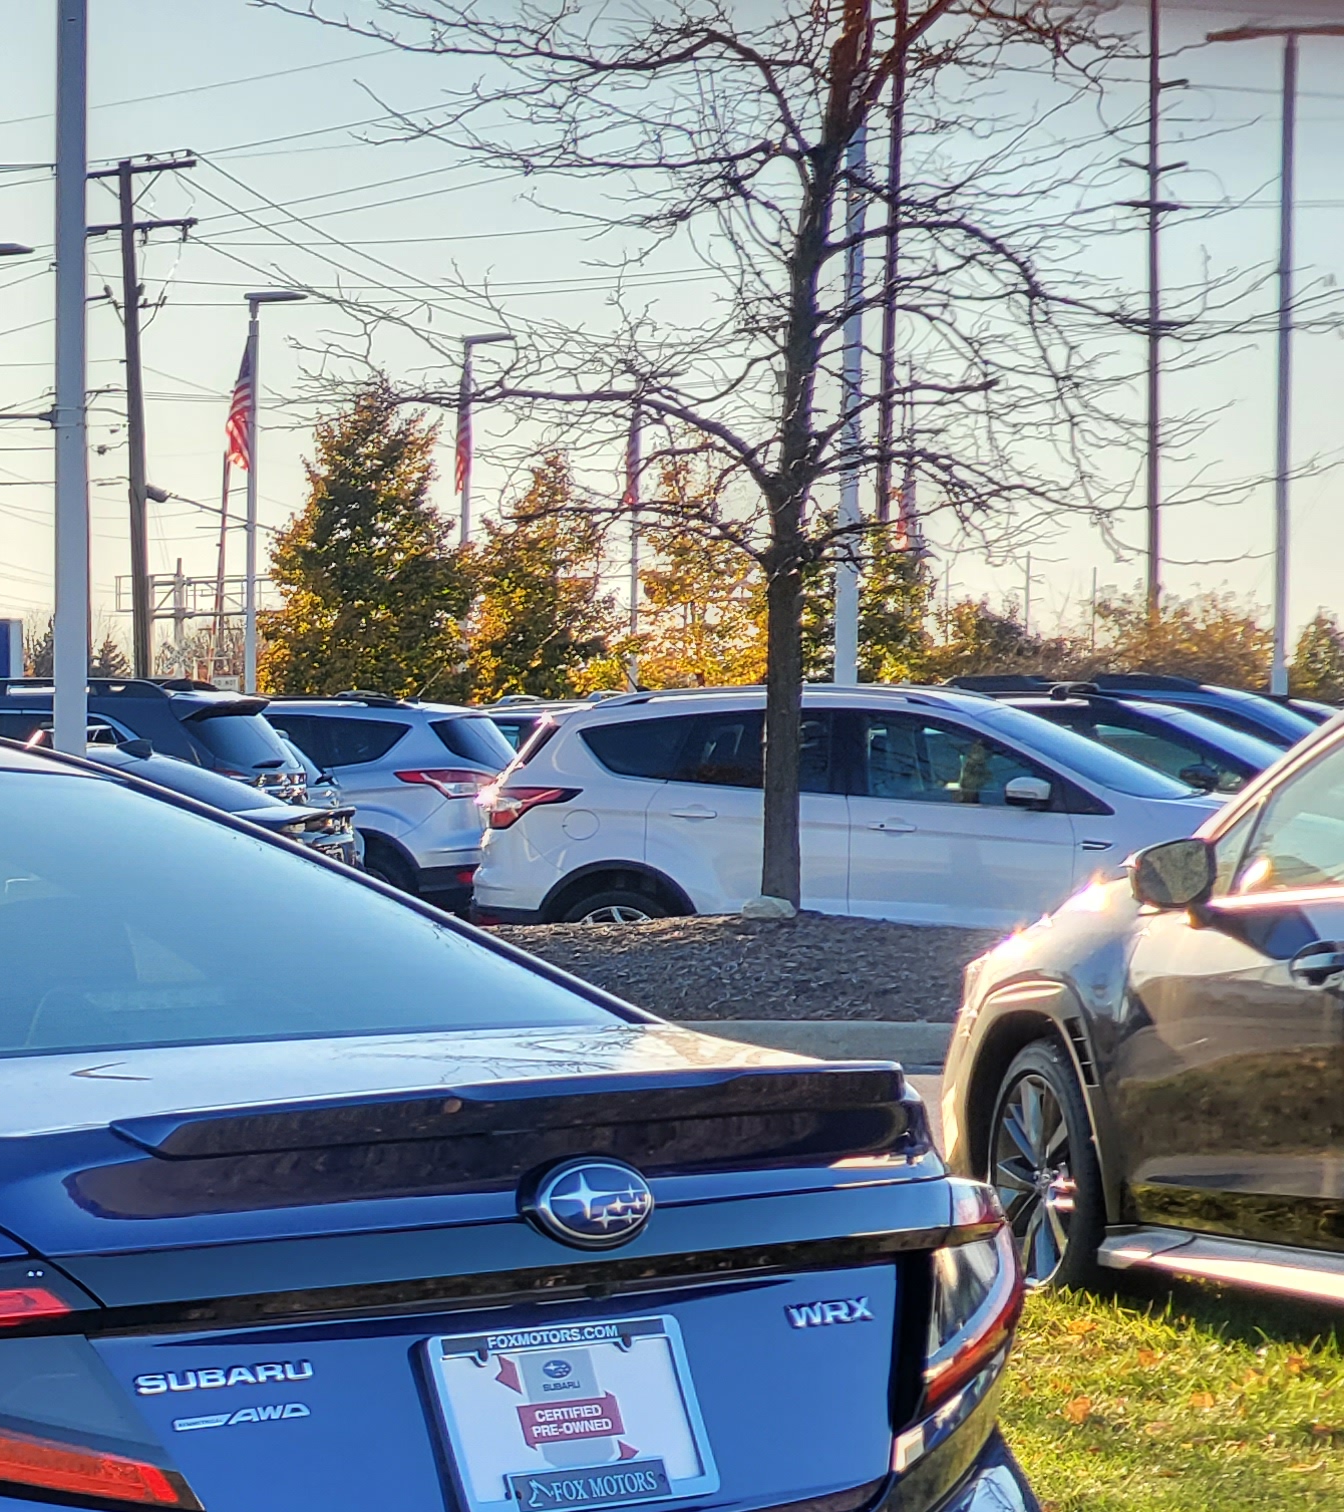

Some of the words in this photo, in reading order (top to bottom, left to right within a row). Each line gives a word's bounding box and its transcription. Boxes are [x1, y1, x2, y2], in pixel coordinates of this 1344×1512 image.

[783, 1296, 874, 1329] WRX
[487, 1325, 618, 1349] FOXMOTORS.COM
[135, 1359, 314, 1396] SUBARU
[542, 1381, 581, 1392] SUBARU
[226, 1402, 311, 1425] AWD
[534, 1404, 602, 1422] CERTIFIED
[532, 1418, 613, 1437] PRE-OWNED
[550, 1479, 589, 1502] FOX
[588, 1471, 658, 1498] MOTORS
